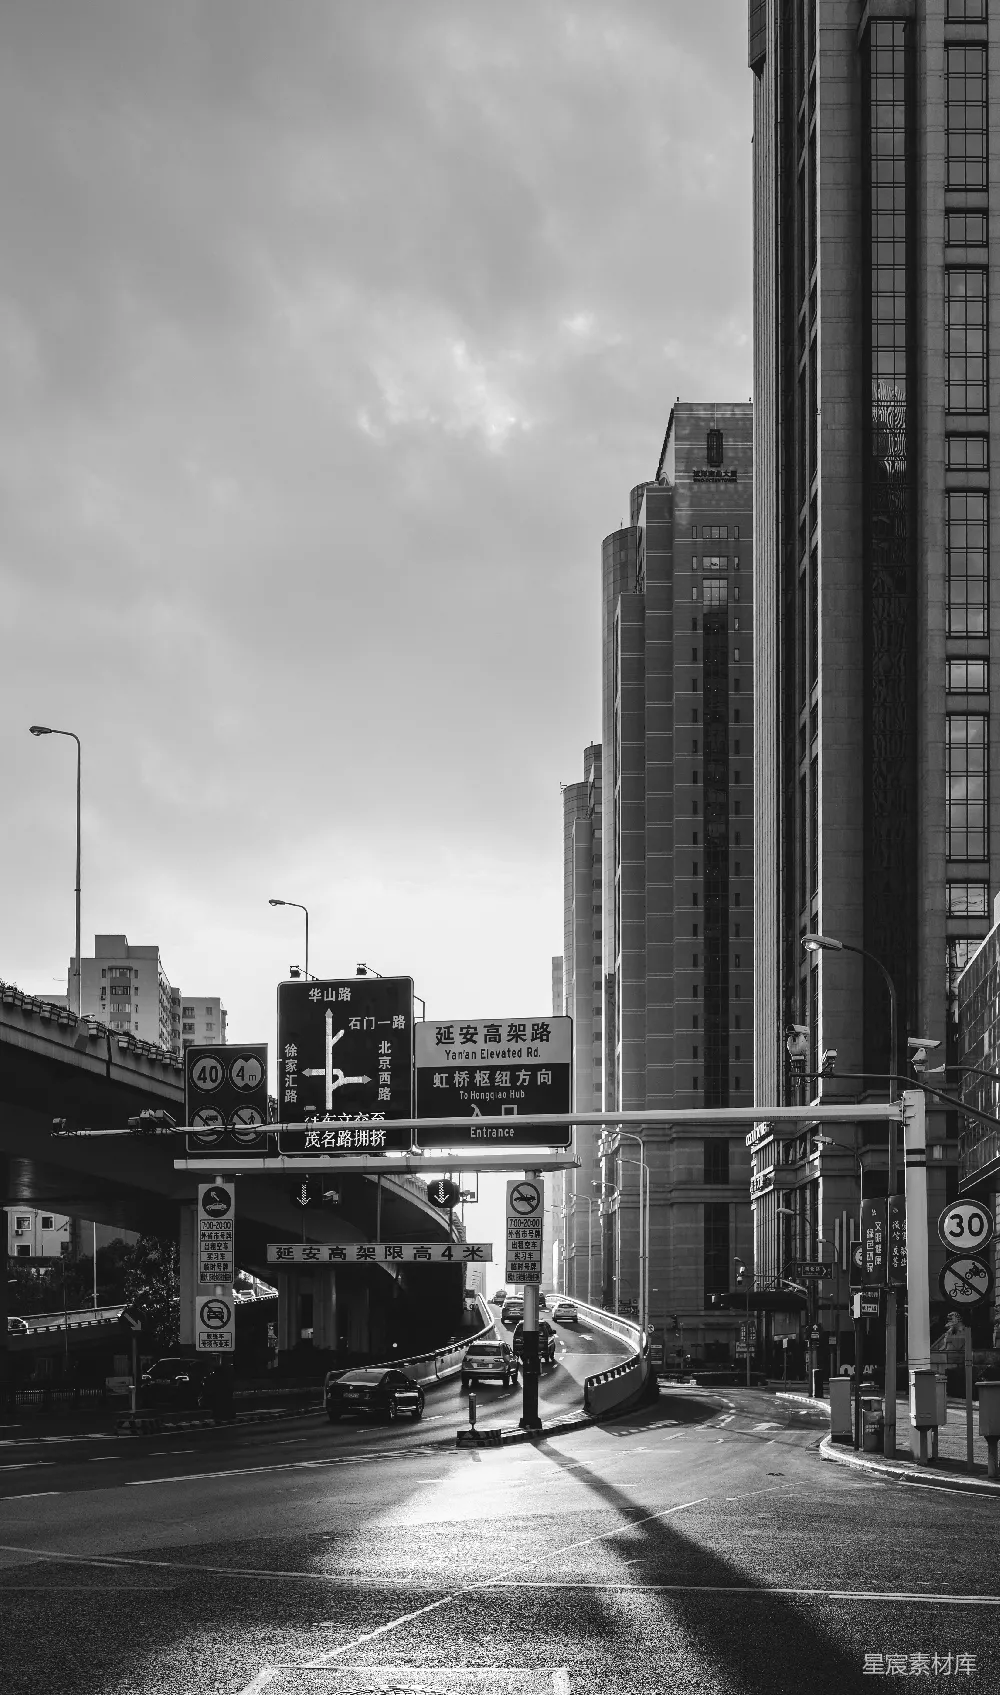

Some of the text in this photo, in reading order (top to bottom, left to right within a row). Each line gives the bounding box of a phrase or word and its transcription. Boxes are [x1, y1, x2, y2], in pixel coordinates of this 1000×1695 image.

[308, 986, 352, 1003] 华山路
[348, 1014, 406, 1030] 石门一路
[435, 1021, 551, 1046] 延安高架路
[444, 1046, 541, 1061] Yan'an Elevated Rd.
[197, 1065, 219, 1084] 40
[284, 1043, 298, 1103] 徐家汇路
[377, 1040, 392, 1101] 北京西路
[433, 1069, 552, 1089] 虹桥枢纽方向
[460, 1090, 469, 1100] To
[510, 1089, 525, 1099] Hub
[304, 1129, 388, 1149] 茂名路拥挤
[470, 1126, 515, 1139] Entrance
[948, 1212, 985, 1238] 30
[275, 1245, 484, 1262] 延安高架限高4米
[511, 1240, 538, 1250] 出租空车
[514, 1251, 534, 1261] 实习车
